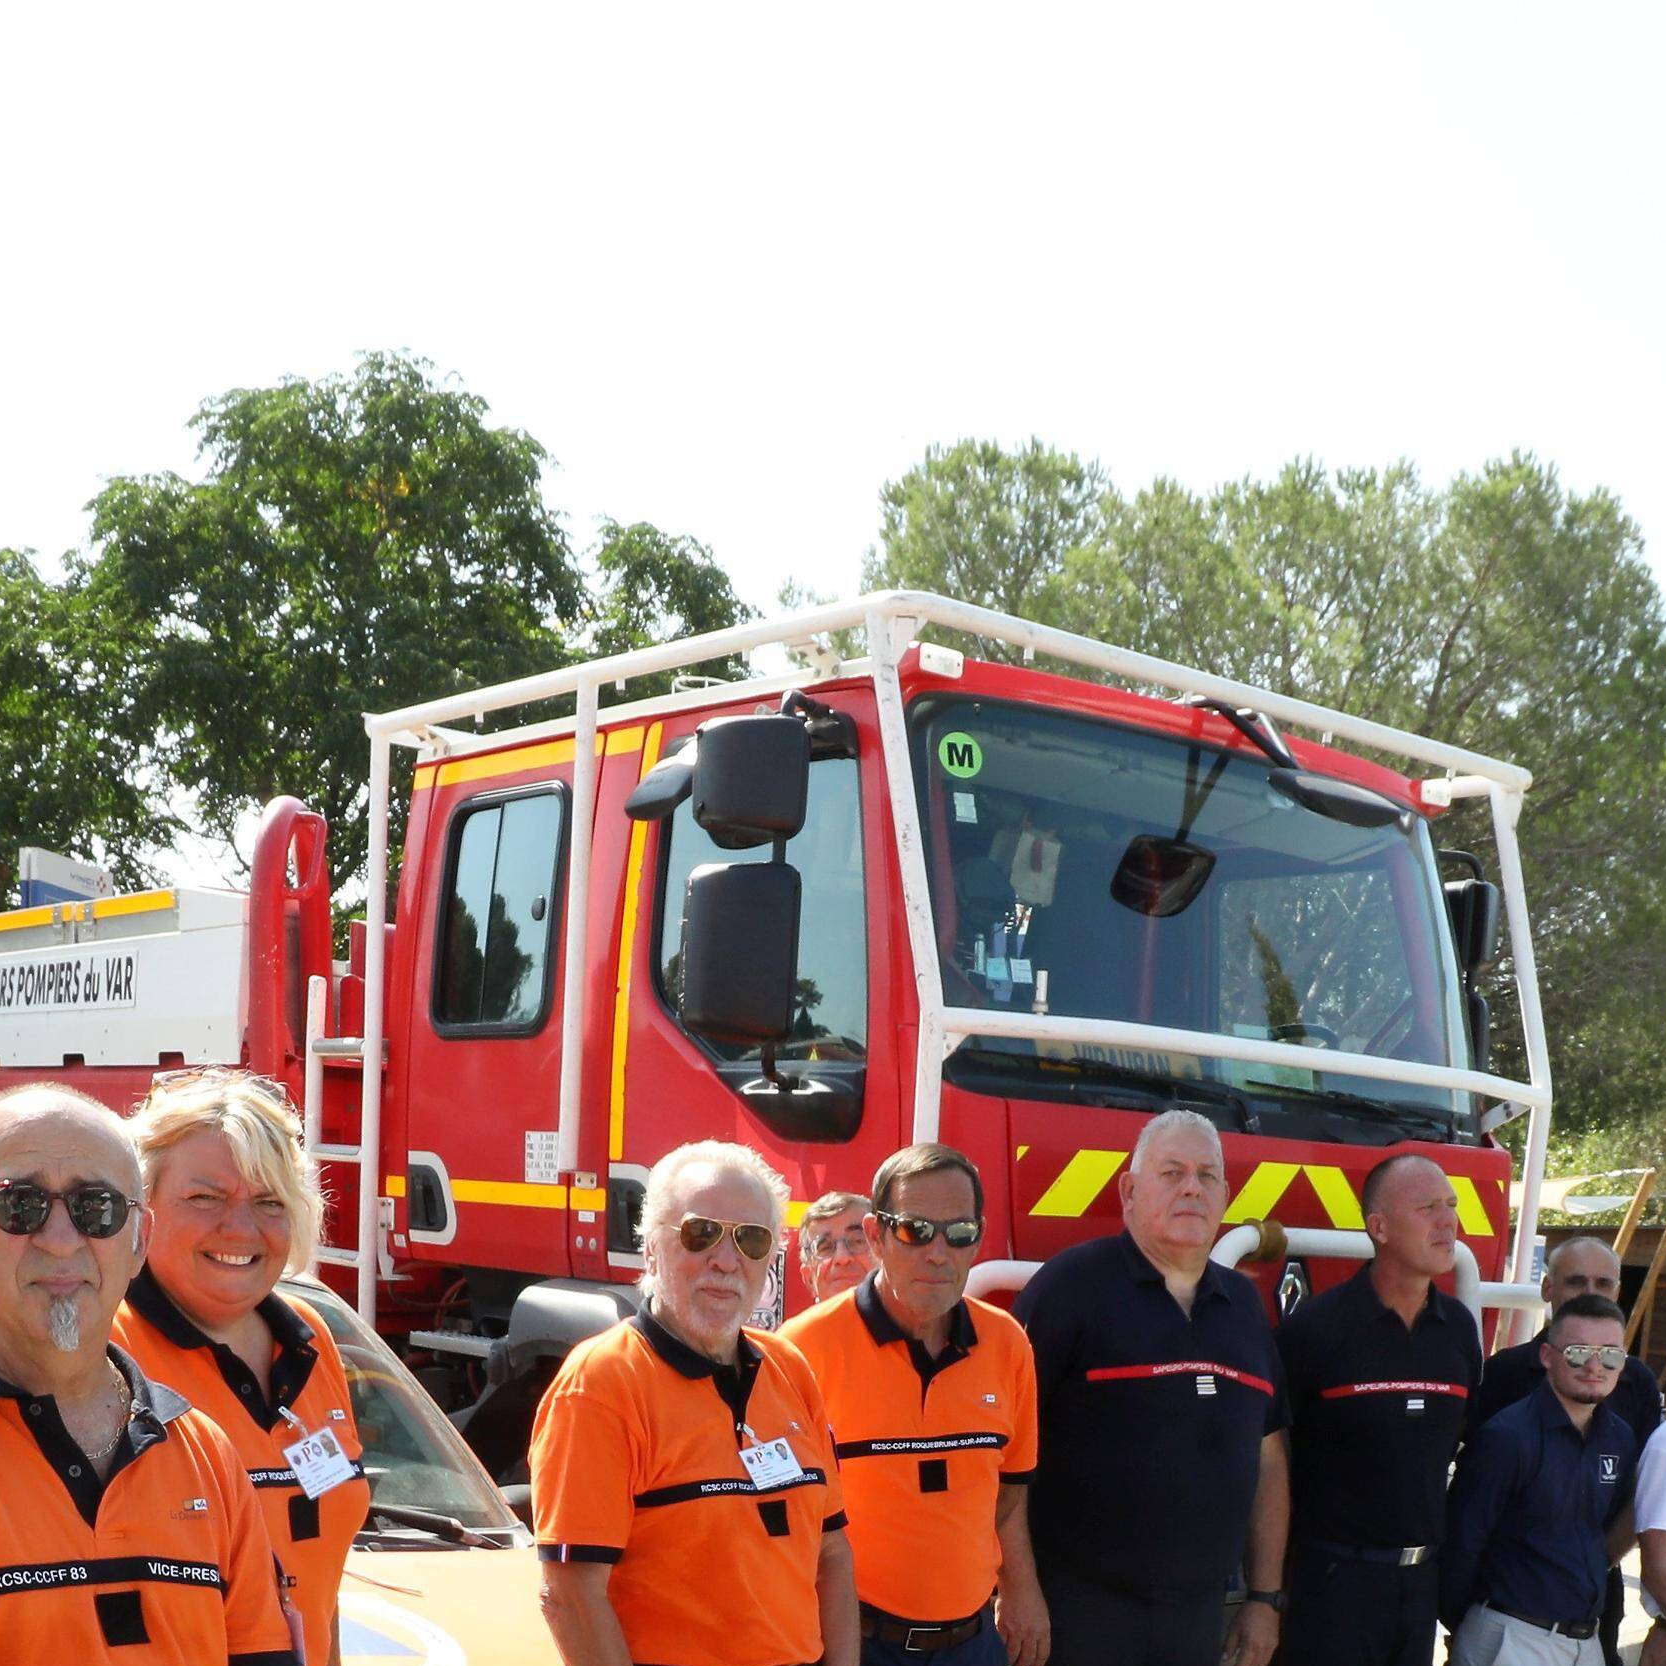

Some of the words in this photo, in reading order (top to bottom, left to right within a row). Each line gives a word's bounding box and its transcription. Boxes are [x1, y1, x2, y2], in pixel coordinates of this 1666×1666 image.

[946, 741, 974, 769] M
[16, 959, 81, 1006] POMPIERS
[83, 957, 100, 1002] du
[106, 955, 133, 1001] VAR
[70, 1566, 88, 1581] 83
